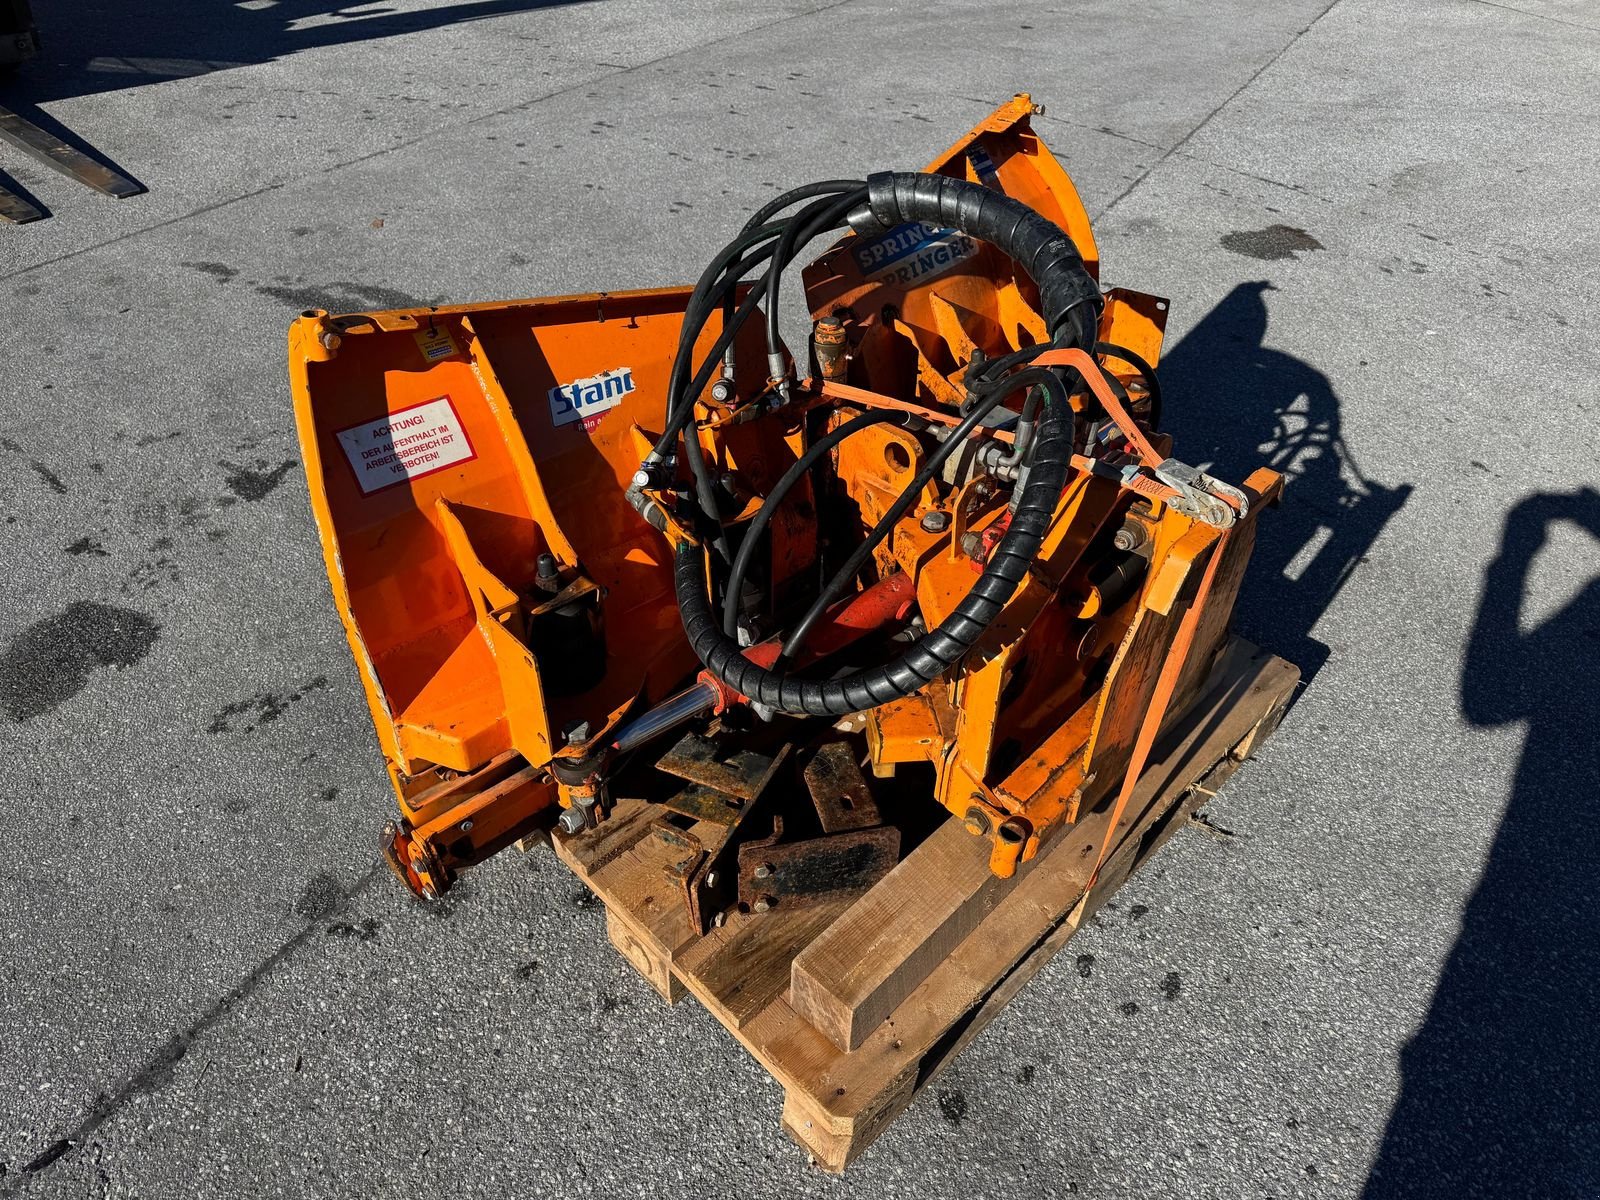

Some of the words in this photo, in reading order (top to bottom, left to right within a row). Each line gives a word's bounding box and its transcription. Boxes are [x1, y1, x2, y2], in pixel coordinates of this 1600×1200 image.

[860, 221, 940, 267] SPRING
[880, 236, 974, 287] PRINGER
[361, 448, 382, 460] DER
[383, 428, 437, 453] AUFENTHALT
[438, 425, 449, 435] IM
[372, 415, 425, 439] ACHTUNG!
[365, 440, 441, 471] ARBEITSBEREICH
[441, 434, 455, 446] IST
[390, 450, 440, 474] VERBOTEN!
